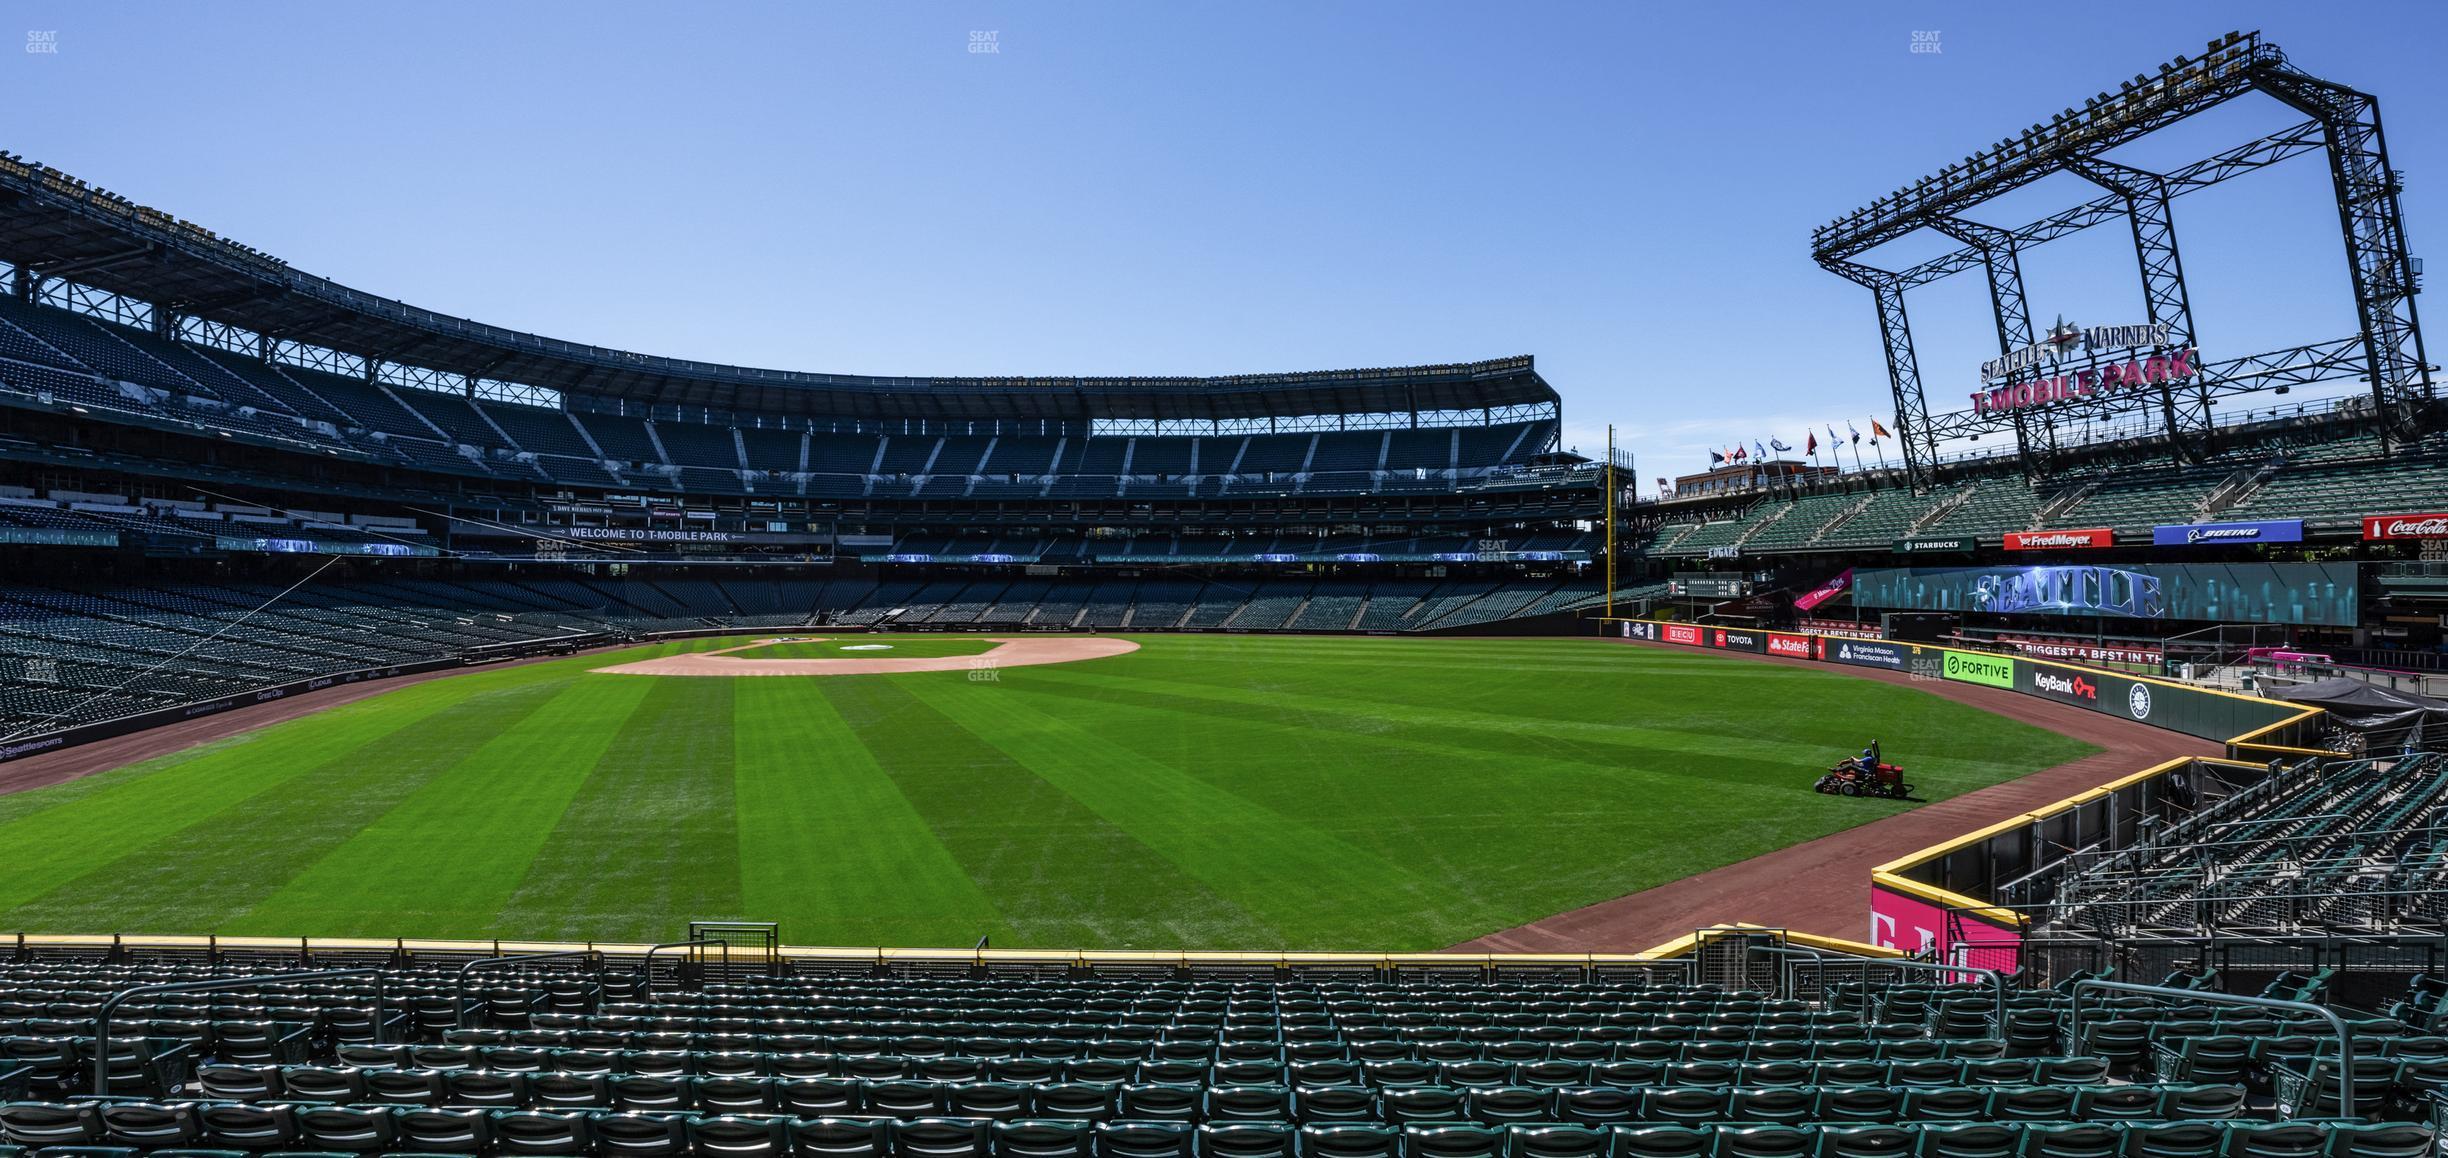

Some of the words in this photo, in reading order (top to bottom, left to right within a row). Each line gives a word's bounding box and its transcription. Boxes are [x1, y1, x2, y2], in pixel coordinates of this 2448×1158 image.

[1981, 342, 2049, 383] SEATTLE
[2083, 323, 2169, 350] MARINERS
[1970, 368, 2099, 415] T-MOBILE
[2102, 346, 2200, 393] PARK
[570, 527, 626, 539] WELCOME
[629, 529, 645, 539] TO
[650, 530, 697, 541] T-MOBILE
[700, 531, 728, 542] PARK
[2203, 528, 2259, 538] BOEING
[1914, 541, 1959, 549] STARBUCKS
[1672, 629, 1694, 639] BECU
[1727, 635, 1753, 645] TOYOTA
[1853, 645, 1873, 653] Virginia
[1874, 647, 1894, 655] Mason
[2026, 644, 2075, 656] BIGGEST
[2079, 649, 2086, 657] &
[2091, 650, 2124, 661] BEST
[2128, 653, 2141, 662] IN
[1853, 653, 1882, 661] Franciscan
[1883, 655, 1901, 664] Health
[1962, 661, 2008, 679] FORTIVE
[2035, 672, 2073, 694] KeyBank
